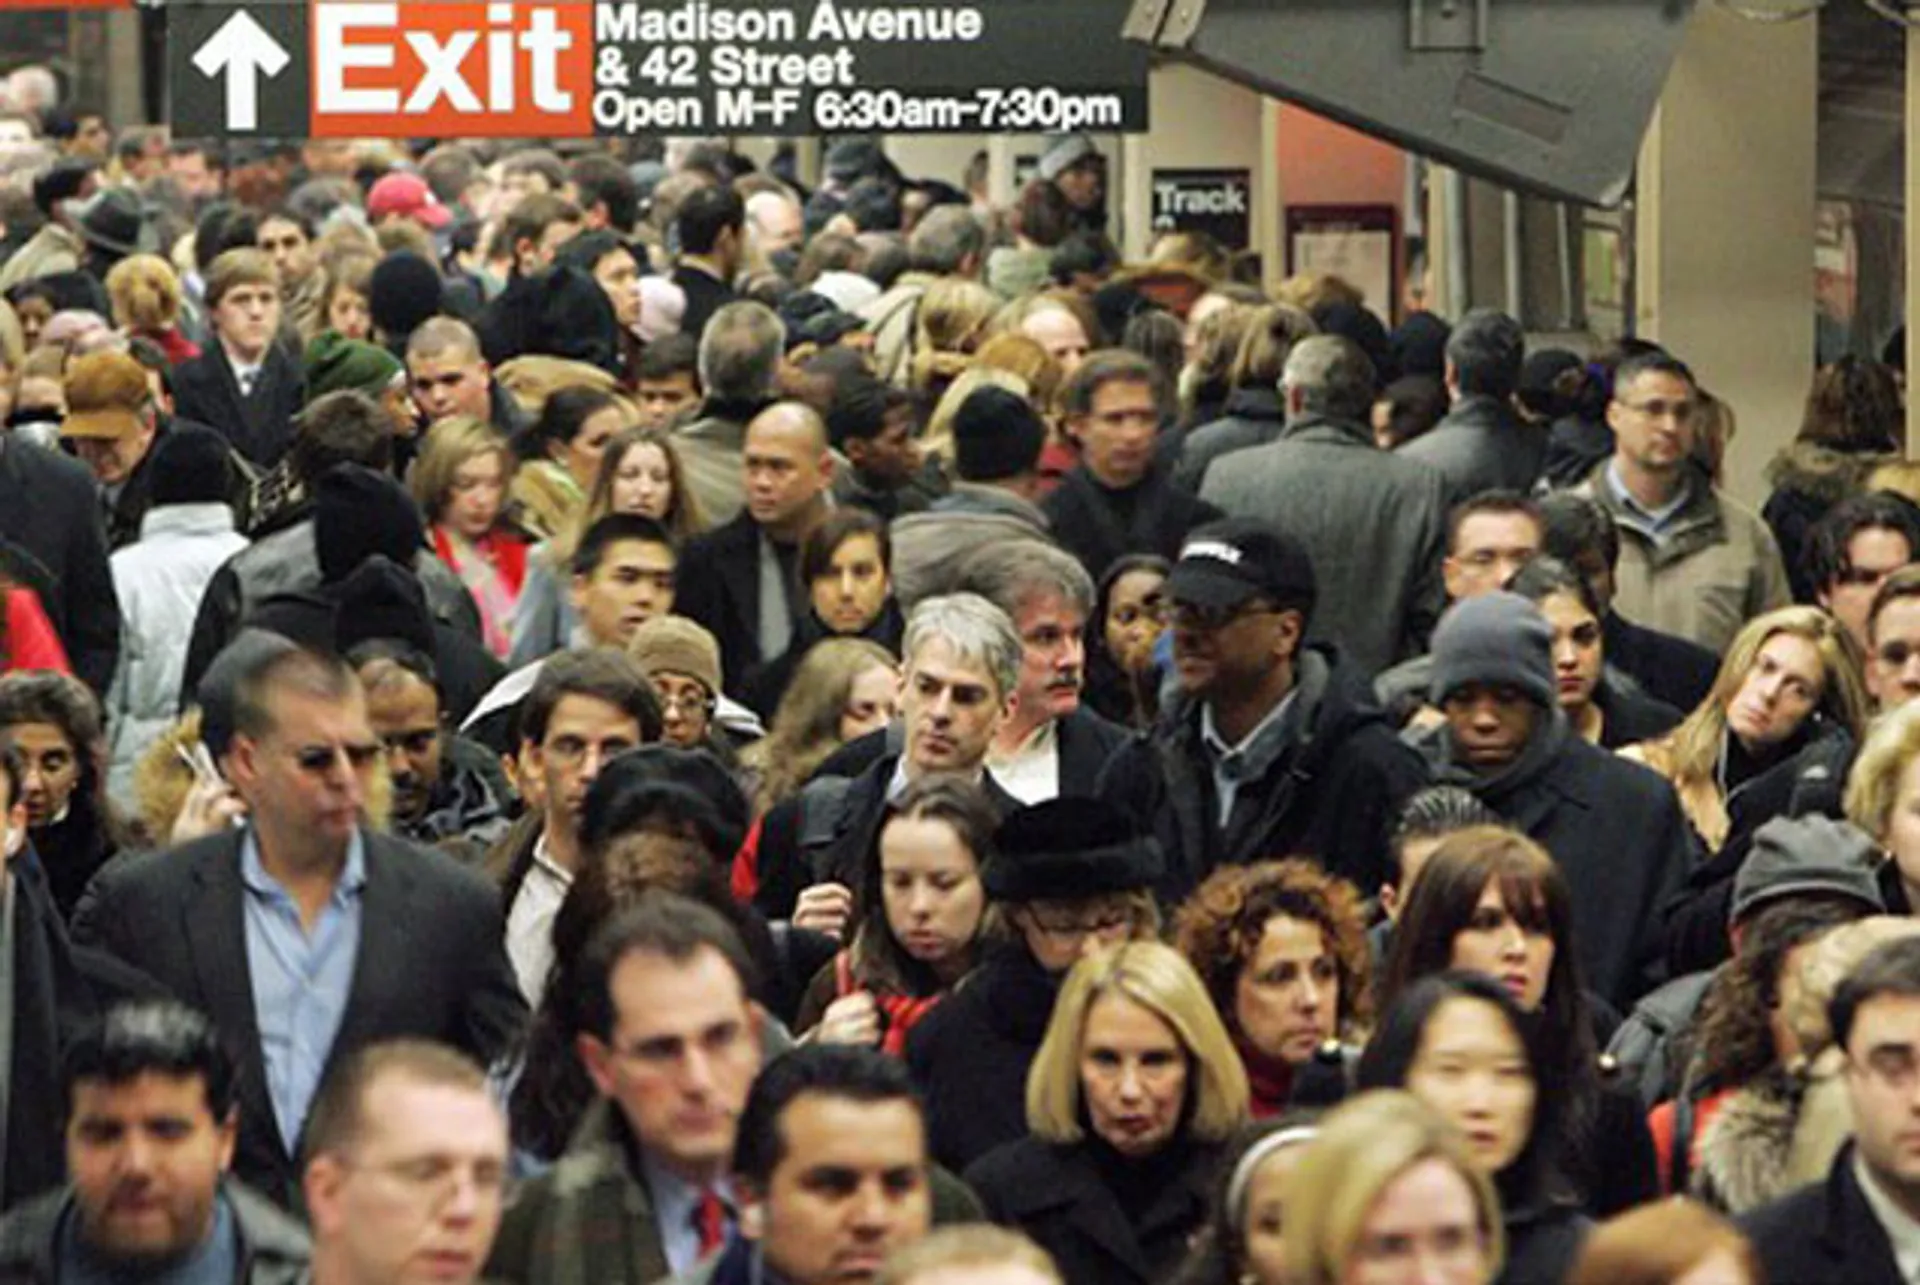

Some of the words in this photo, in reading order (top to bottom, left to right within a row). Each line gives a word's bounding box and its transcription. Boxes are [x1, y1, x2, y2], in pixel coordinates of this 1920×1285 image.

[595, 2, 795, 42] Madison
[807, 0, 983, 41] Avenue
[316, 2, 574, 114] Exit
[595, 46, 631, 86] &
[639, 46, 698, 86] 42
[710, 45, 855, 86] Street
[592, 89, 703, 134] Open
[716, 89, 801, 126] M-F
[814, 87, 1122, 131] 6:30am-7:30pm
[1153, 182, 1246, 214] Track
